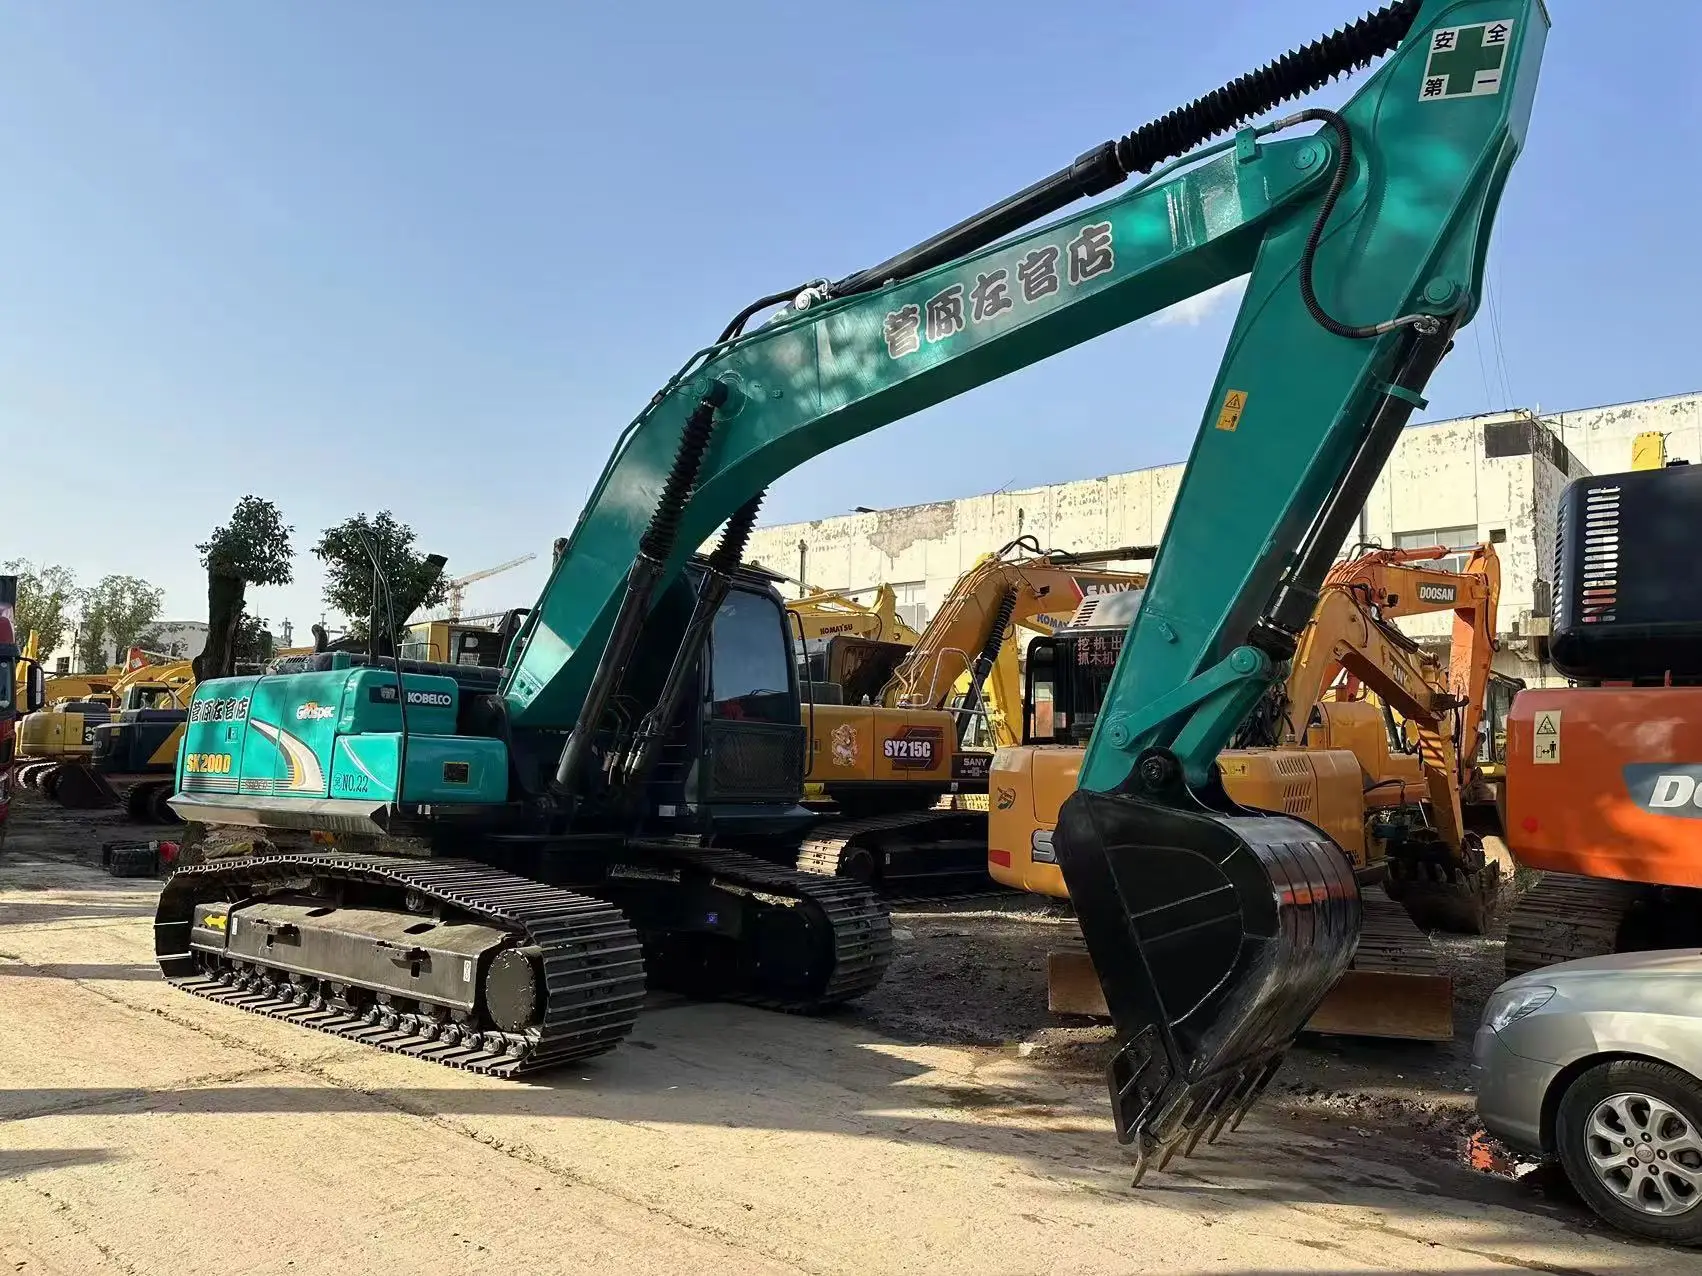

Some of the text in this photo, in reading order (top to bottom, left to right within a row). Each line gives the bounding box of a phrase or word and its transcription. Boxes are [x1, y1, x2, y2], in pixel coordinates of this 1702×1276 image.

[1420, 587, 1454, 600] DOOSAN
[820, 623, 853, 635] KOMATSU
[1078, 652, 1120, 666] 抓木机
[407, 692, 451, 706] KOBELCO
[884, 739, 931, 758] SY215C
[963, 758, 987, 767] SANY
